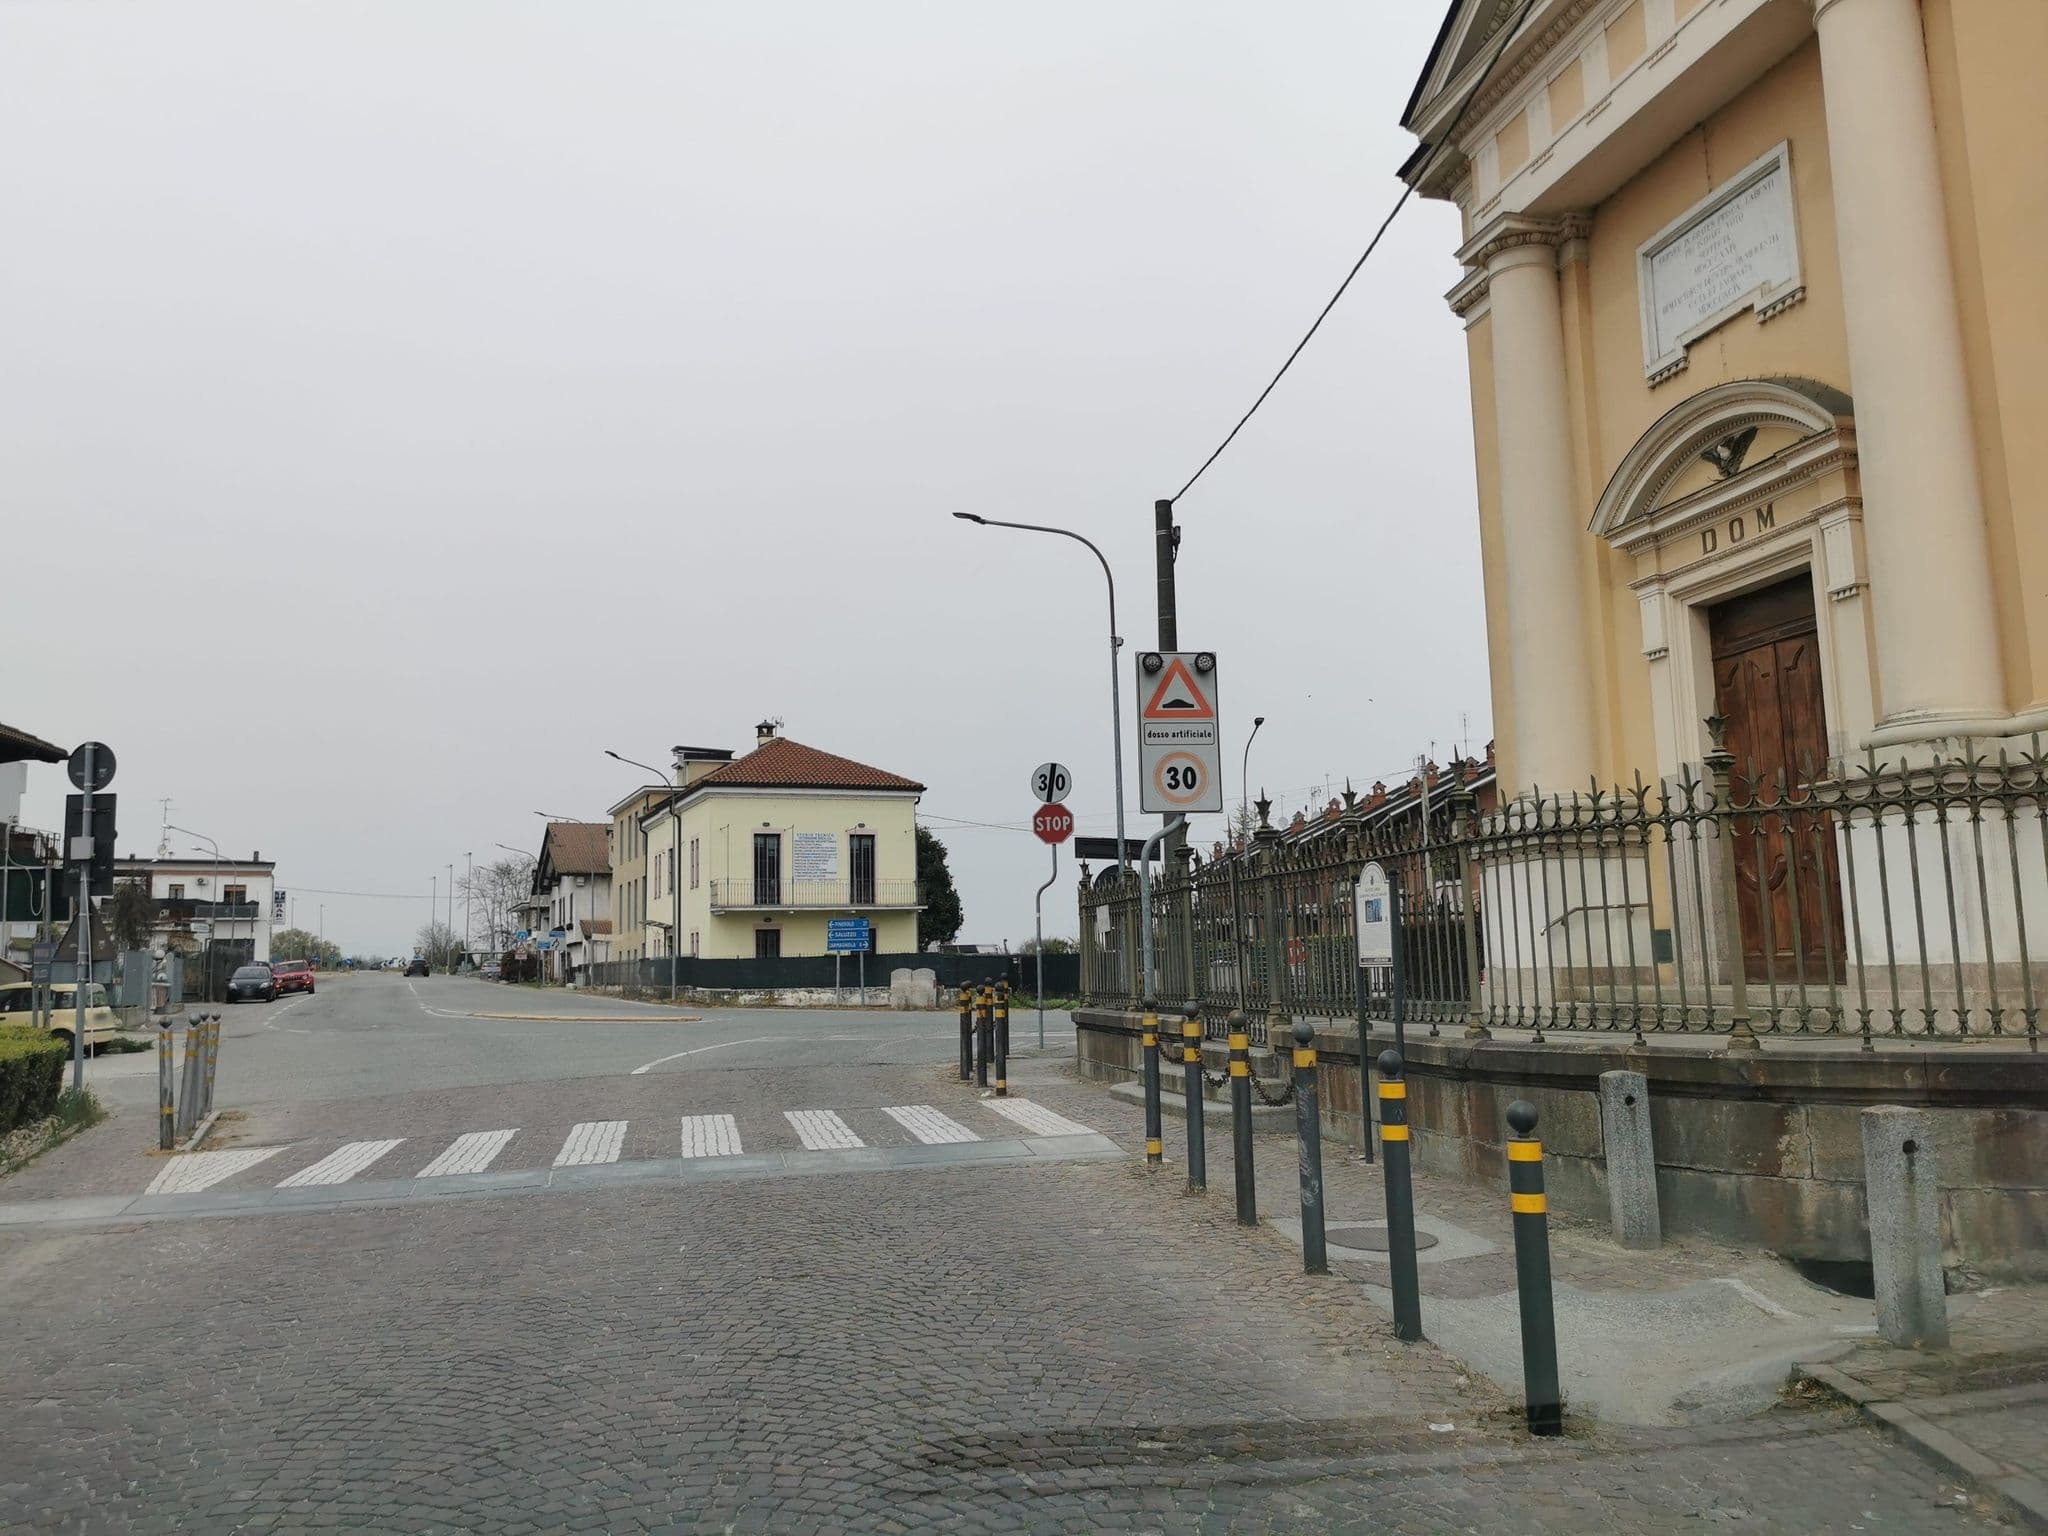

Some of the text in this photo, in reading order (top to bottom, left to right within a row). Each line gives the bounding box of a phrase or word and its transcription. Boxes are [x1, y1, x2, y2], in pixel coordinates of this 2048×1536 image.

[1147, 728, 1213, 739] dosso artificiale
[1166, 766, 1197, 790] 30
[1035, 815, 1071, 832] STOP
